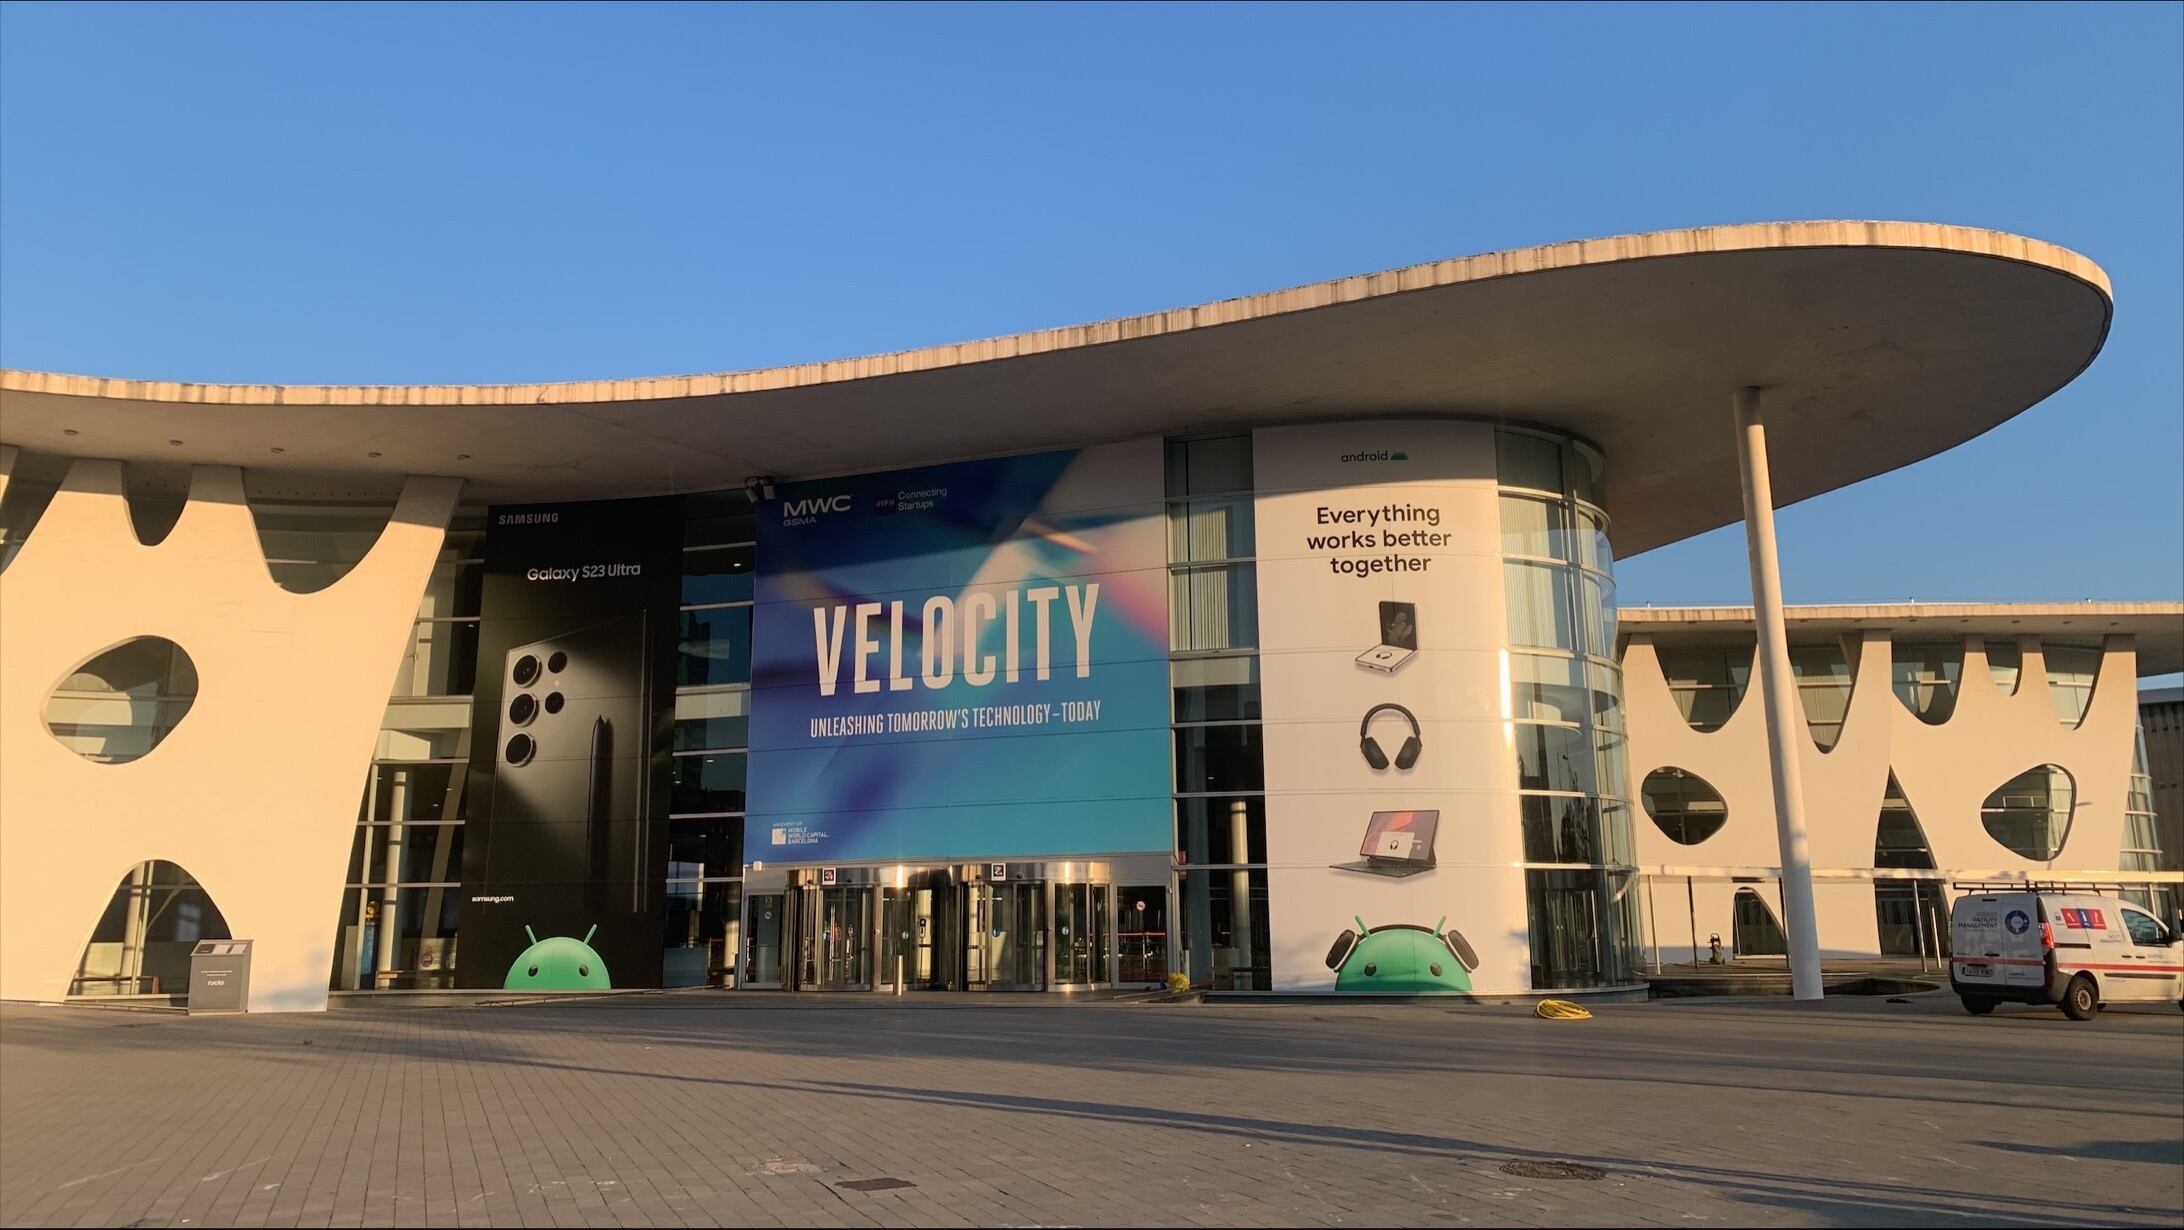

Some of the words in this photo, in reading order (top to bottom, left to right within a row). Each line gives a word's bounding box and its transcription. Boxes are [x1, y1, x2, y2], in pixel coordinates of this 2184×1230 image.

[1341, 450, 1388, 463] android
[897, 487, 948, 500] Connecting
[783, 494, 851, 518] MWC
[897, 500, 934, 512] Startups
[1316, 503, 1440, 528] Everything
[499, 512, 559, 526] SAMSUNG
[783, 516, 817, 527] GSMA
[1306, 531, 1376, 550] works
[1383, 529, 1452, 547] better
[527, 567, 580, 582] Galaxy
[582, 564, 606, 579] S23
[608, 563, 641, 577] Ultra
[1330, 554, 1432, 578] together
[813, 583, 1100, 696] VELOCITY
[810, 715, 884, 738] UNLEASHING
[887, 708, 969, 733] TOMORROW'S
[472, 896, 514, 904] samsung.com
